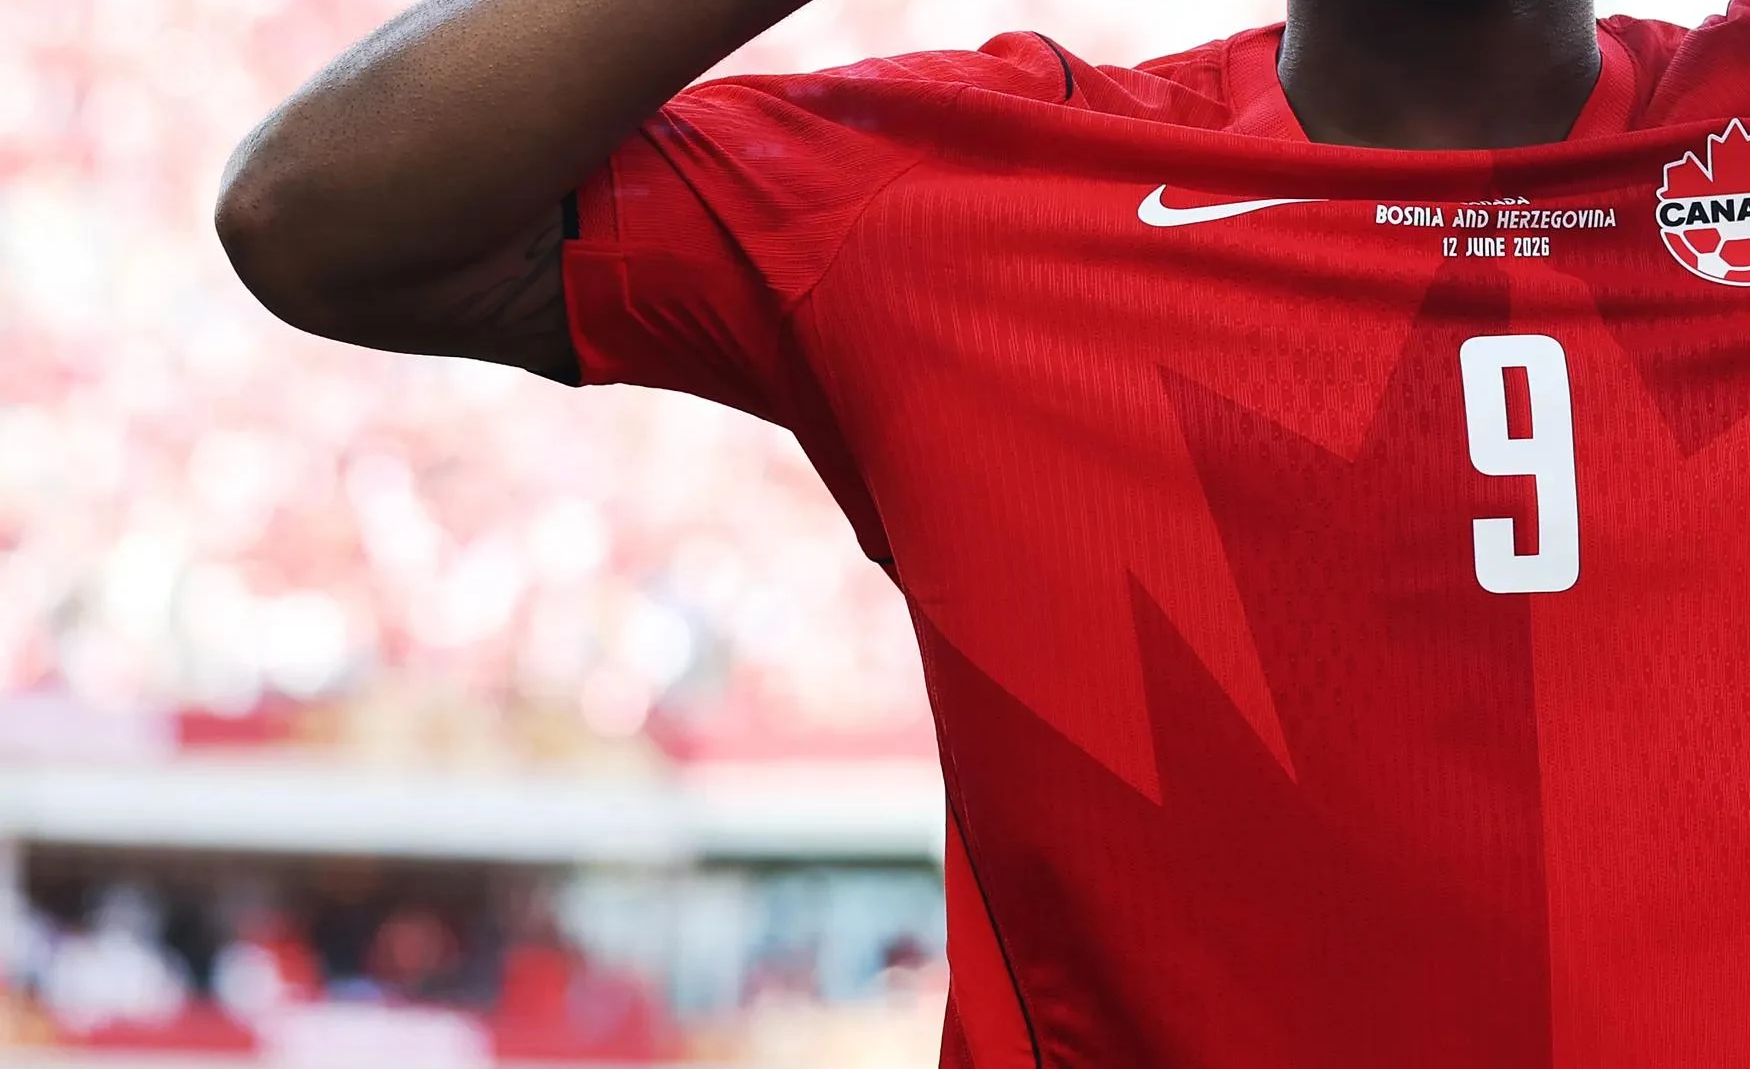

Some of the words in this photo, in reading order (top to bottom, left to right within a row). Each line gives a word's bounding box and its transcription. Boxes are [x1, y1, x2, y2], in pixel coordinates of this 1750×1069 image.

[1461, 196, 1530, 206] NADA
[1375, 204, 1445, 228] BOSNIA
[1451, 208, 1489, 228] AND
[1496, 208, 1616, 229] HERZEGOVINA
[1442, 237, 1458, 257] 12
[1465, 236, 1506, 257] JUNE
[1513, 236, 1550, 257] 2026
[1459, 334, 1580, 594] 9
